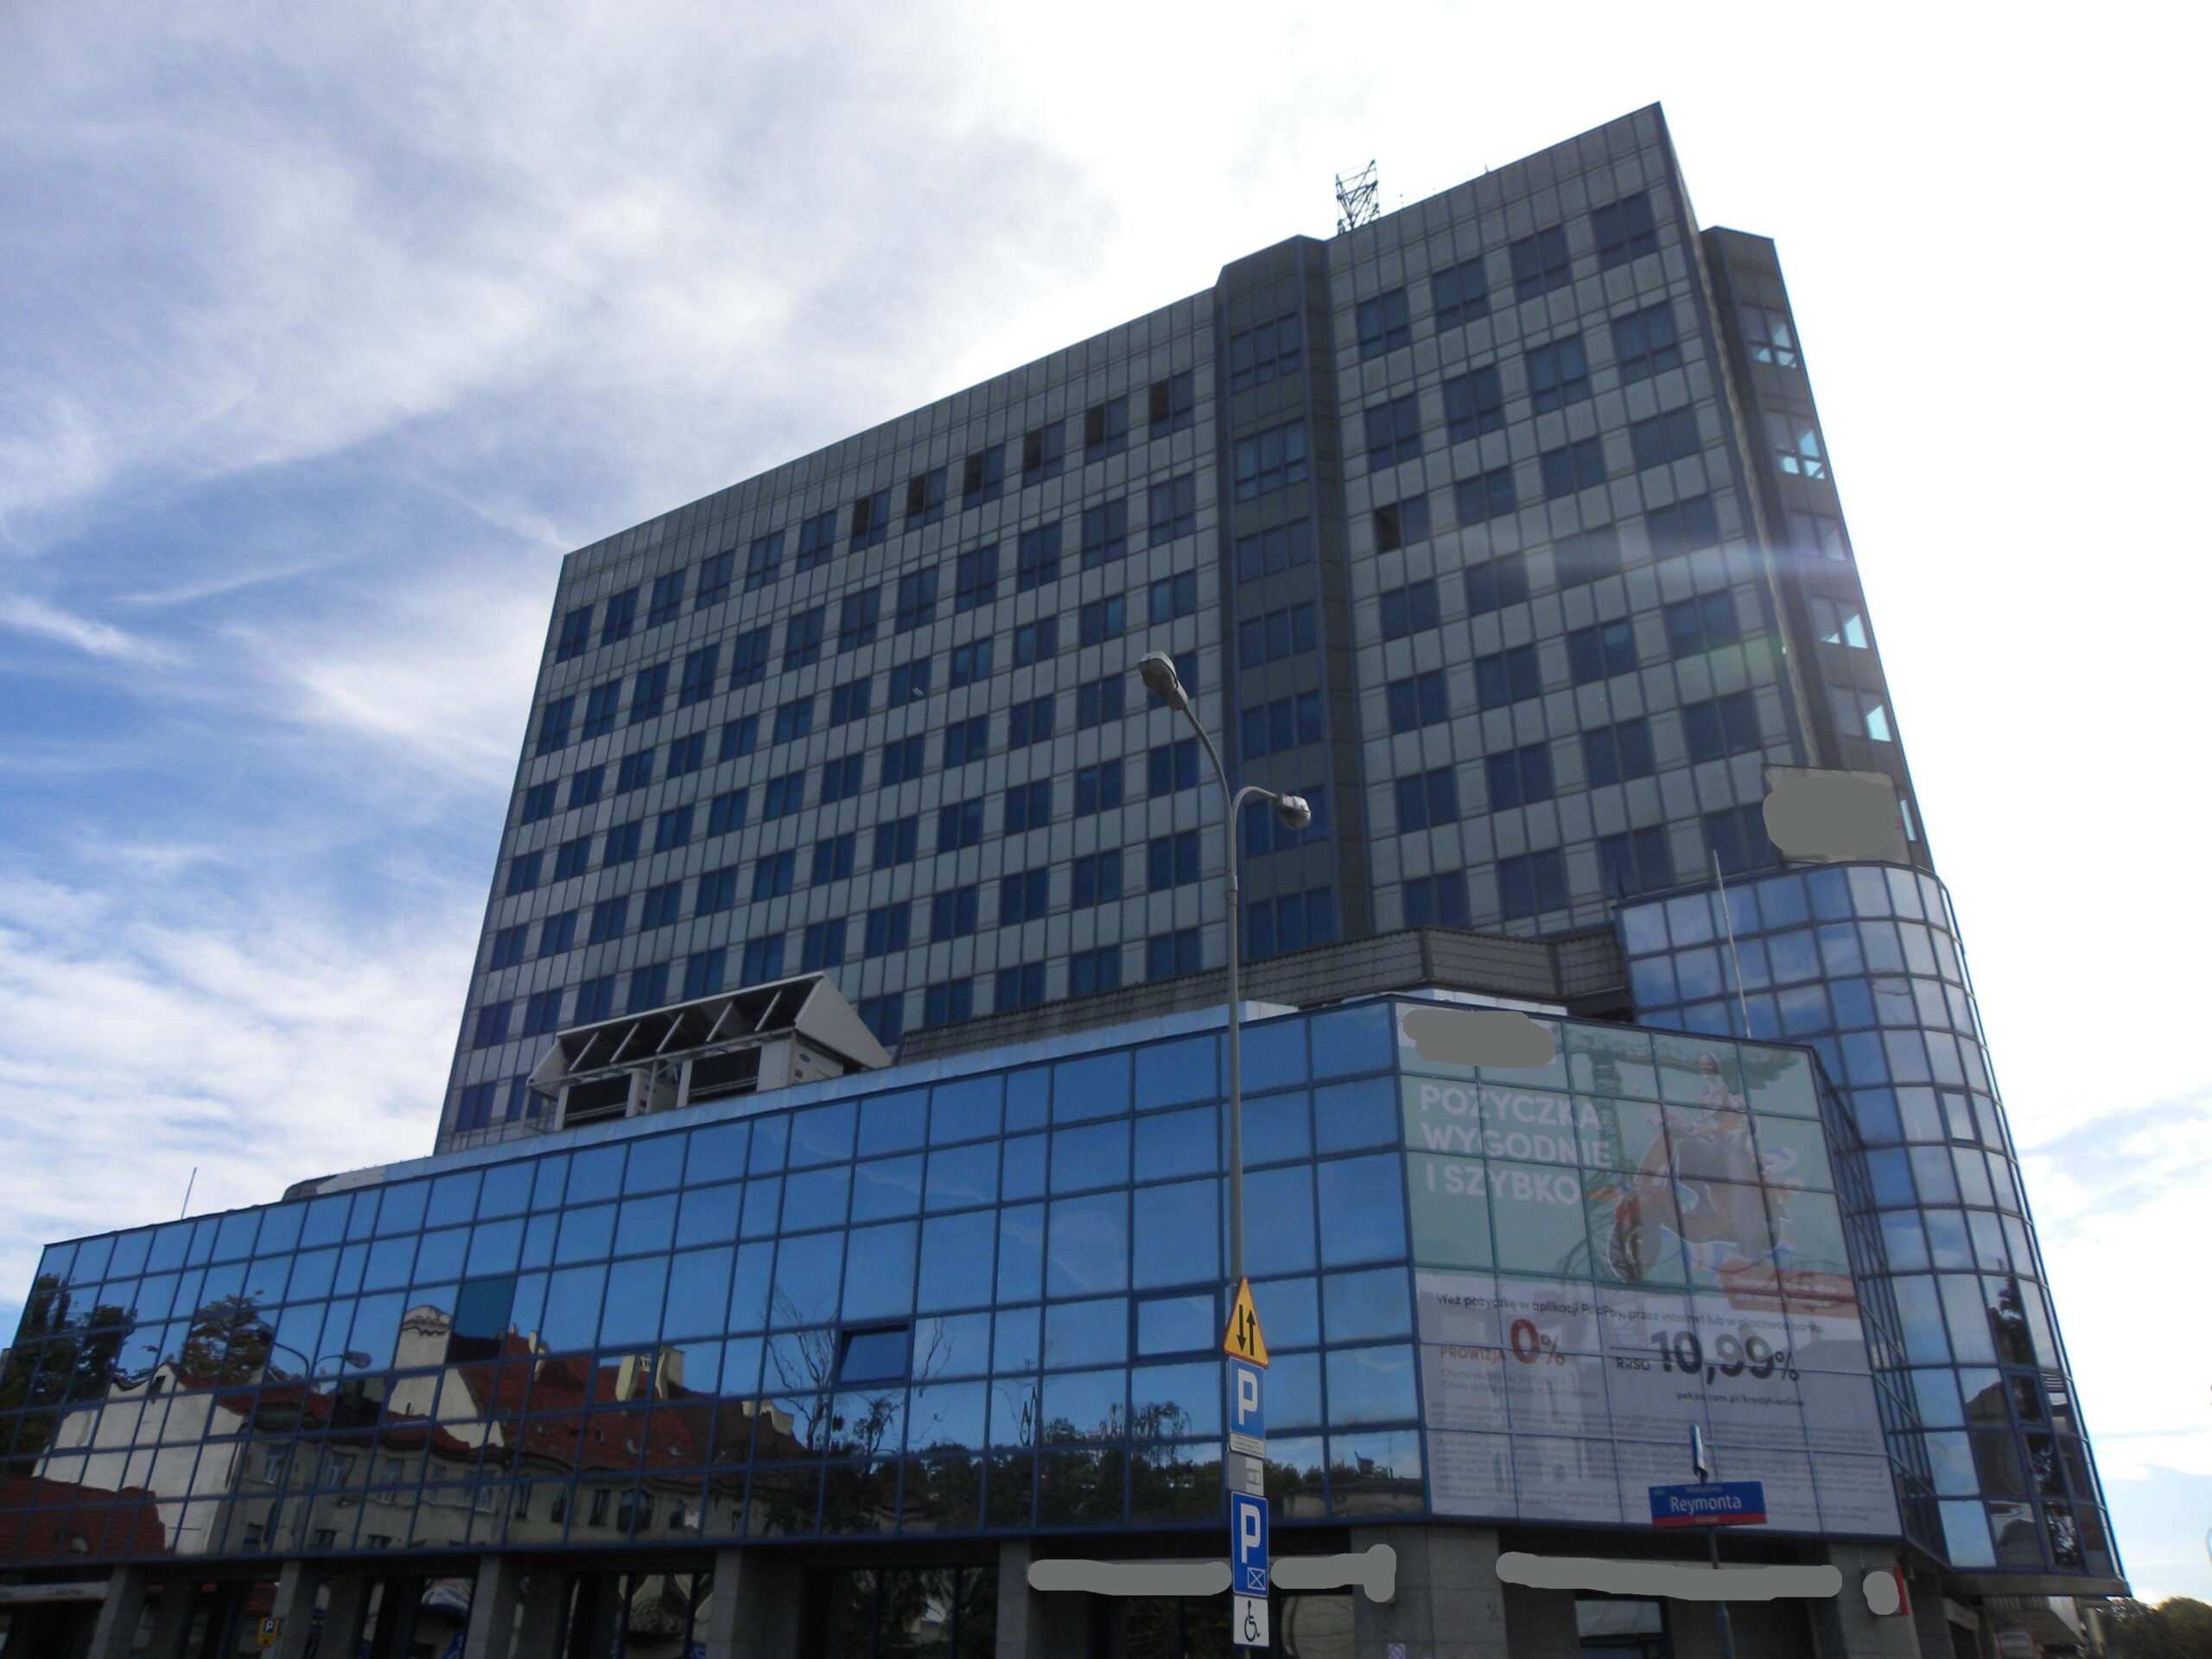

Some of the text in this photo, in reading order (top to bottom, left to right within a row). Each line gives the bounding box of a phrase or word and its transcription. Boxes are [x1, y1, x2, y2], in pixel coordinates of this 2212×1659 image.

[1421, 1121, 1612, 1169] WYGODNIE
[1426, 1161, 1581, 1205] I SZYBKO
[1532, 1299, 1580, 1317] aplikacji
[1440, 1318, 1567, 1366] PROWIZJA 0%
[1237, 1369, 1258, 1426] P
[1669, 1495, 1742, 1516] Reymonta
[1240, 1503, 1261, 1564] P
